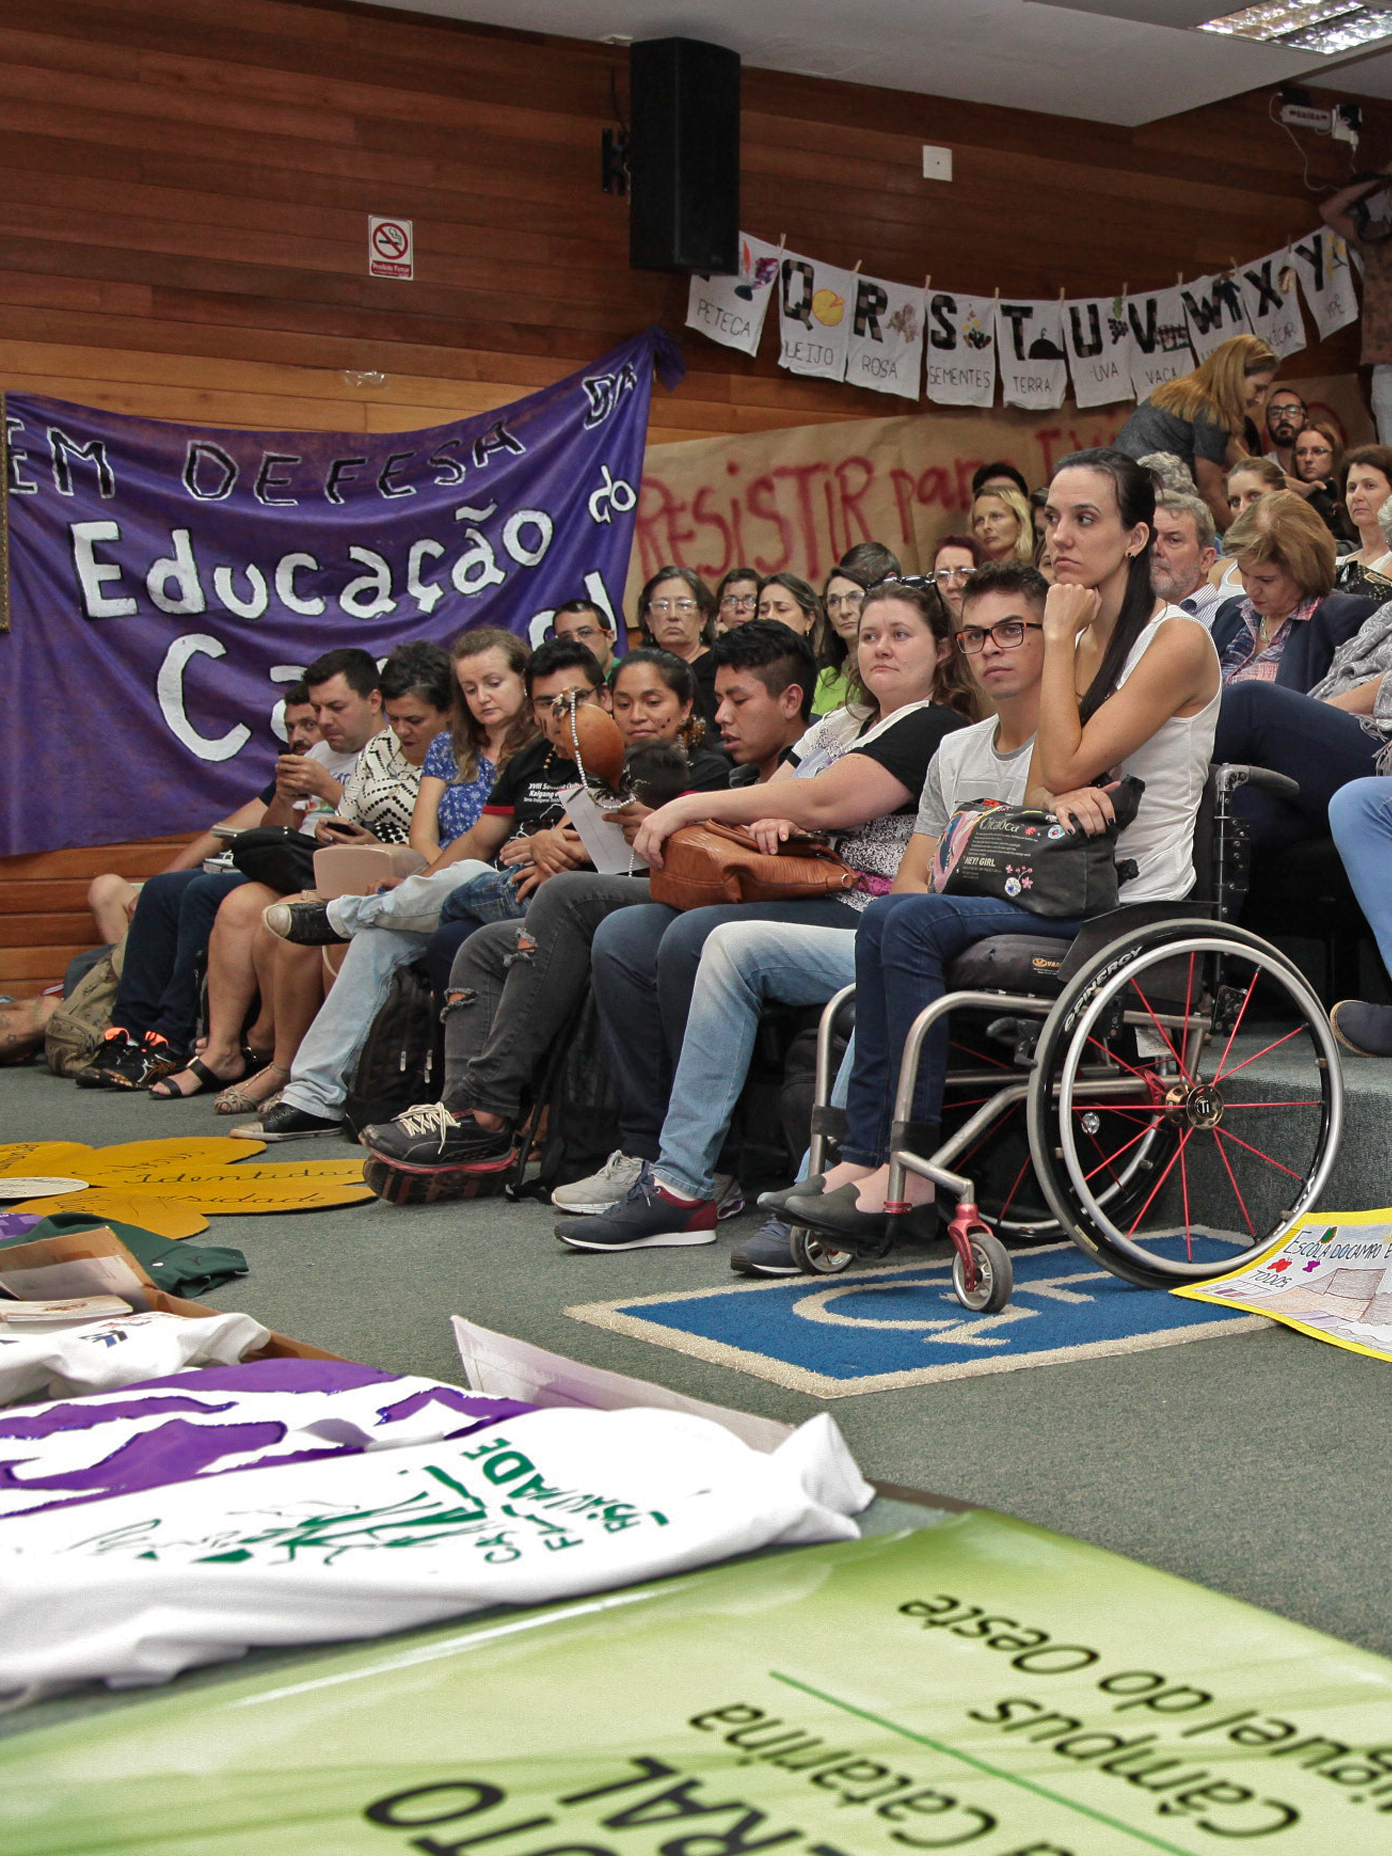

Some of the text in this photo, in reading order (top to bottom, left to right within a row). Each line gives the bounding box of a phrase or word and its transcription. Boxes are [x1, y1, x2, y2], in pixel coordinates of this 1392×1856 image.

[1243, 260, 1284, 318] X
[1294, 234, 1324, 292] Y
[697, 298, 751, 338] PETECA
[782, 258, 815, 331] Q
[853, 279, 889, 343] R
[930, 294, 958, 350] S
[1180, 278, 1223, 336] W
[1000, 303, 1034, 361] T
[1068, 302, 1103, 359] U
[1127, 298, 1158, 354] V
[861, 354, 898, 380] ROSA
[928, 365, 991, 389] SEMENTES
[1012, 375, 1053, 395] TERRA
[5, 416, 116, 499] EM
[182, 421, 527, 507] DEFESA
[70, 465, 638, 620] Educação do
[964, 856, 996, 867] HEY! GIRL
[1065, 945, 1142, 1032] SPINERGY
[1200, 1099, 1210, 1114] Ti
[1283, 1230, 1328, 1259] ESCOLA
[897, 1592, 1101, 1677] Oeste
[1098, 1669, 1214, 1713] do
[688, 1701, 998, 1849] Catarina
[966, 1695, 1301, 1839] Câmpus
